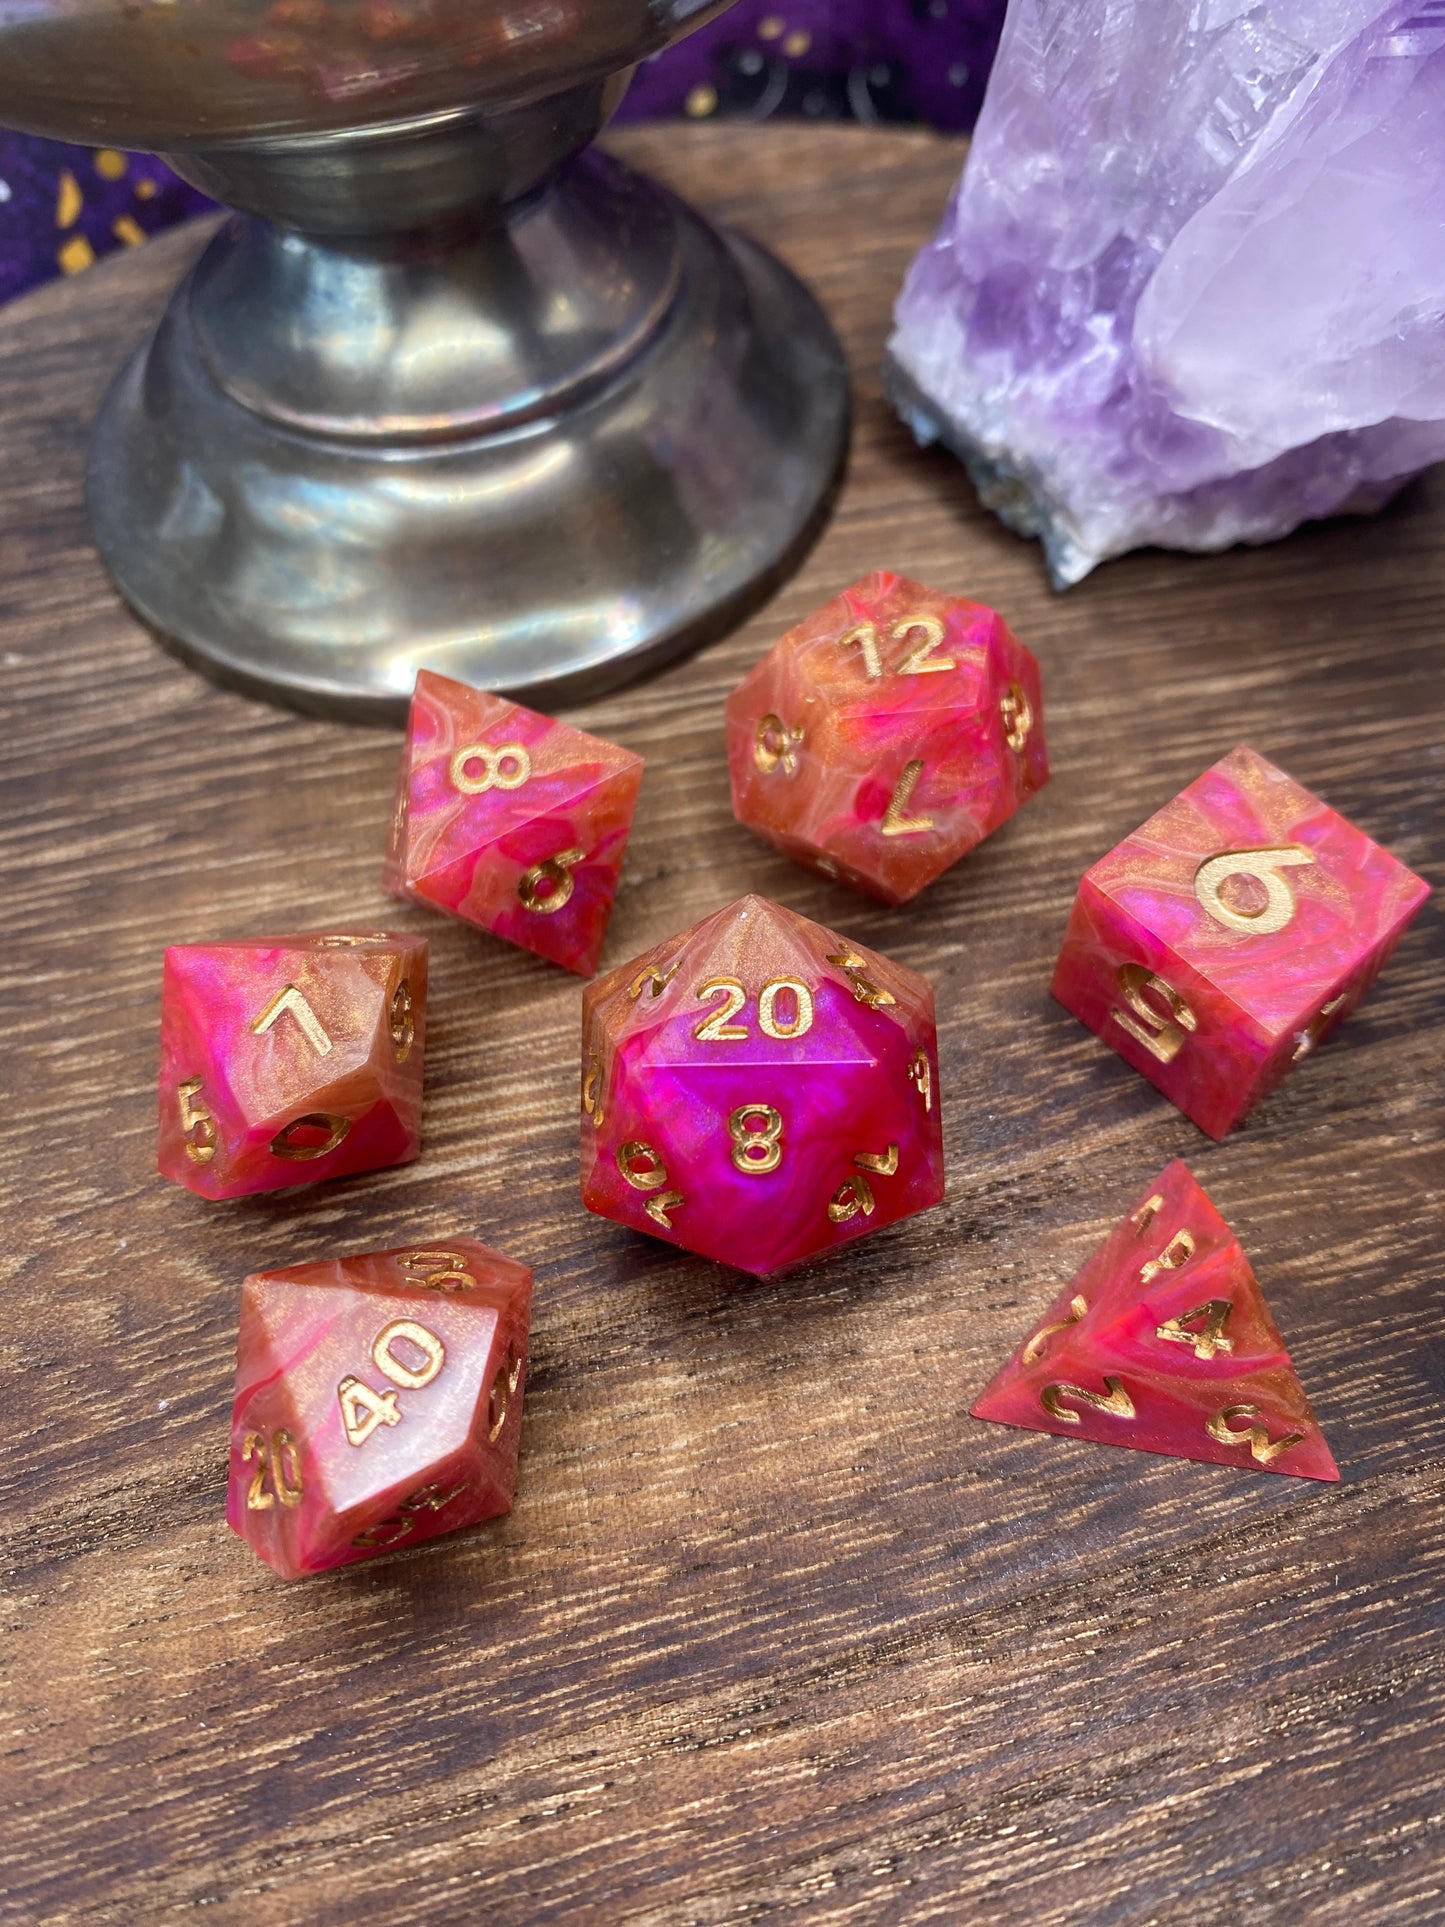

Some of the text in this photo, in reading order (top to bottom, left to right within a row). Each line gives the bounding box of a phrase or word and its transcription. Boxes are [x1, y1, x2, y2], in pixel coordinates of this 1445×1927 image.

[837, 615, 956, 679] 12
[450, 742, 531, 794] 8
[882, 759, 934, 837] 7
[518, 849, 586, 914] 6
[1194, 841, 1316, 935] 6
[251, 983, 334, 1057] 7
[694, 974, 815, 1042] 20
[1110, 961, 1197, 1064] 5
[178, 1074, 217, 1165] 5
[269, 1112, 350, 1161] 0
[729, 1103, 783, 1174] 8
[615, 1141, 685, 1229] 10
[828, 1143, 899, 1223] 16
[1156, 1299, 1234, 1360] 4
[337, 1317, 445, 1447] 40
[1039, 1376, 1136, 1425] 2
[242, 1427, 304, 1511] 20
[1205, 1404, 1305, 1464] 3
